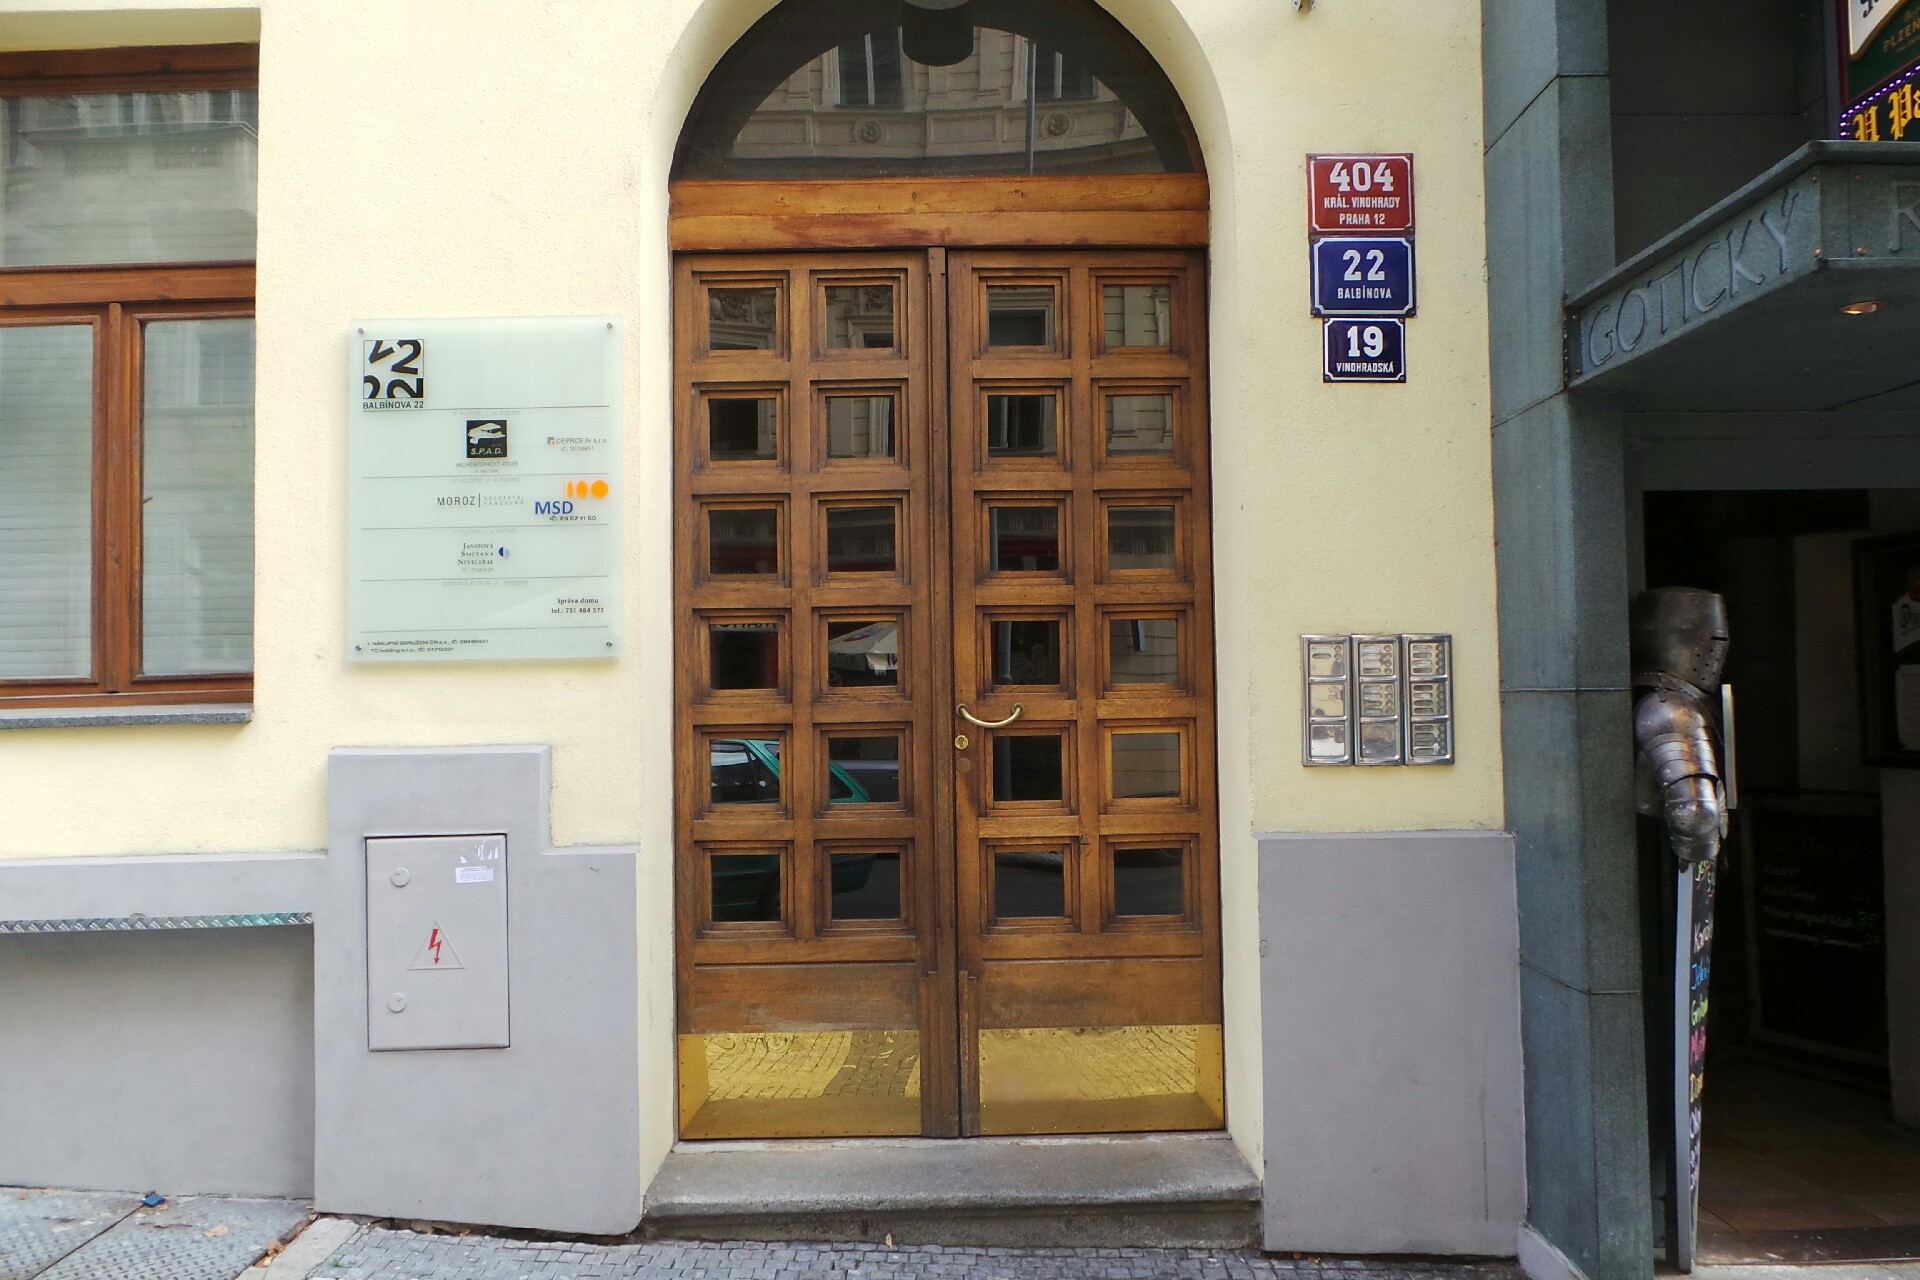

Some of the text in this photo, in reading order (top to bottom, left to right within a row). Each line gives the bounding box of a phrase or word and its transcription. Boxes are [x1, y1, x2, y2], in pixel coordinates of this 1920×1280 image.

[1329, 161, 1394, 192] 404
[1323, 193, 1401, 209] KRÁL. VINOHRADY
[1339, 213, 1386, 225] PRAHA 12
[1342, 249, 1386, 281] 22
[1337, 285, 1392, 299] BALBÍNOVA
[1346, 325, 1384, 358] 19
[1336, 361, 1394, 373] VINOHRADSKÁ
[363, 400, 424, 409] BALBÍNOVA 22
[470, 447, 504, 455] S.P.A.D.
[437, 496, 475, 506] MOROZ
[534, 501, 574, 515] MSD
[557, 597, 579, 605] Správa
